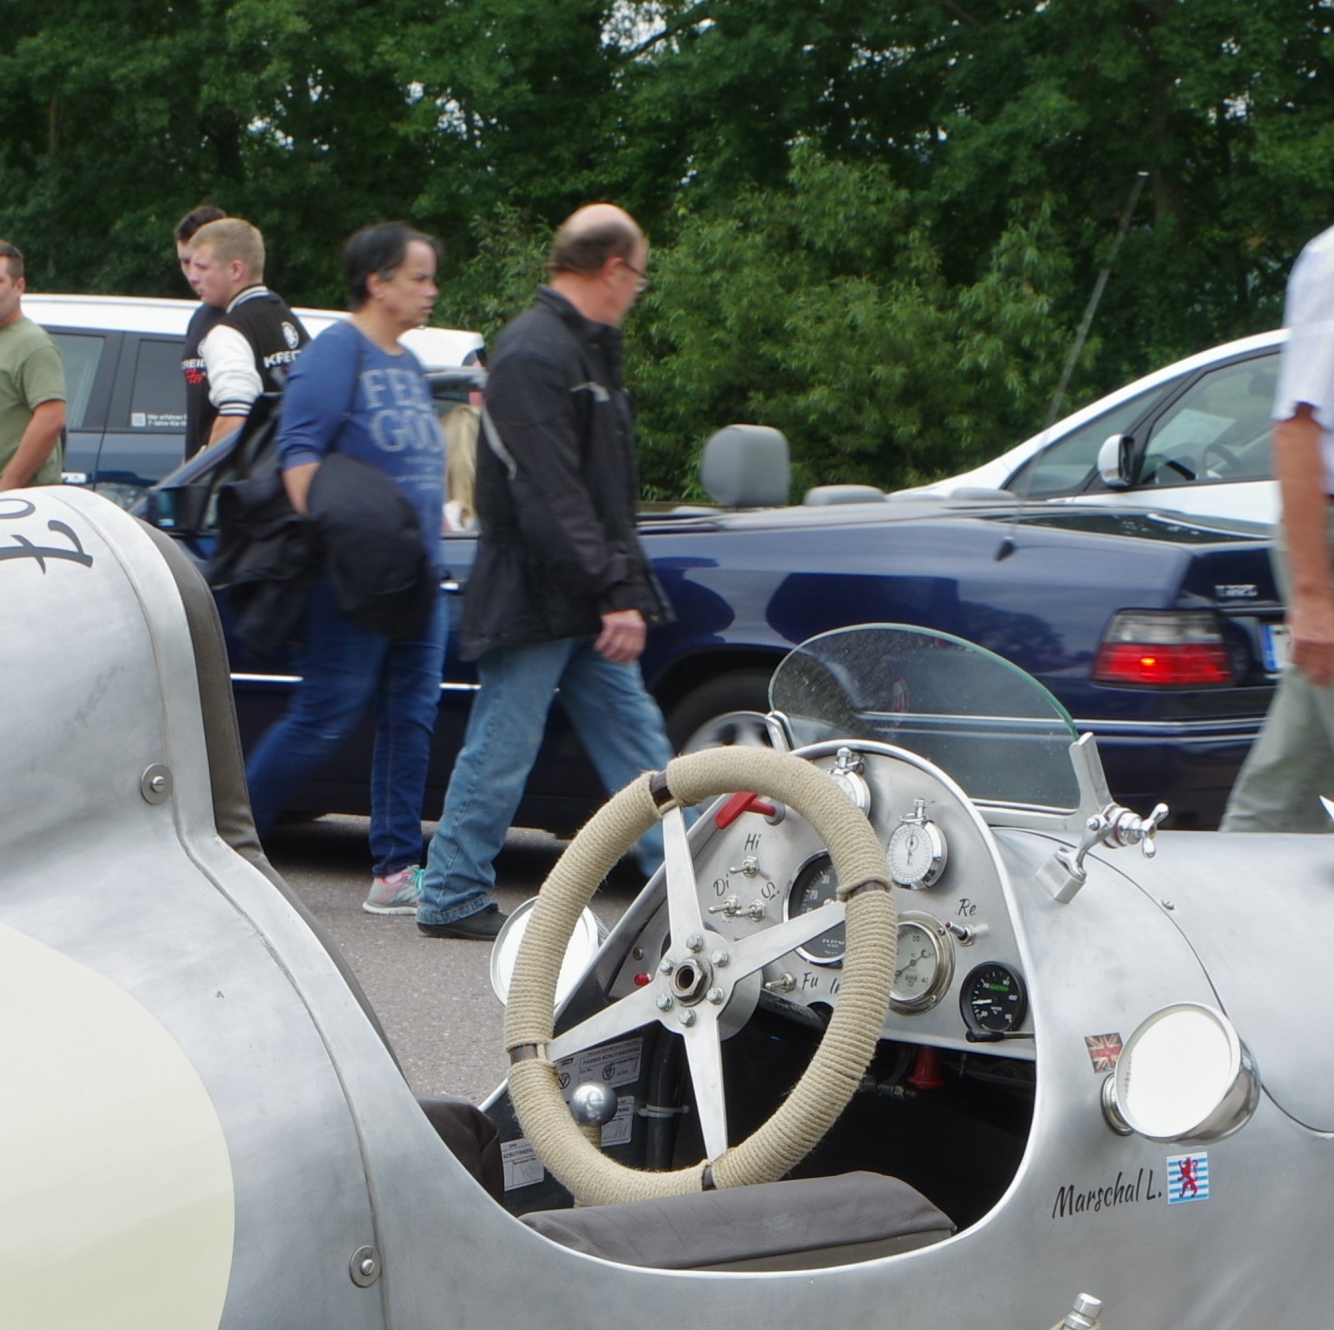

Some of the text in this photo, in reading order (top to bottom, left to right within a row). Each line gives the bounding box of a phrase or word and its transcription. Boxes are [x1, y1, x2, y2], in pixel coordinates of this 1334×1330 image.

[744, 833, 762, 851] Hi
[713, 874, 730, 897] Di
[761, 881, 780, 901] Si
[809, 889, 819, 900] 20
[957, 899, 977, 916] Re
[802, 971, 819, 990] Fu
[1052, 1168, 1162, 1219] Marschal L.
